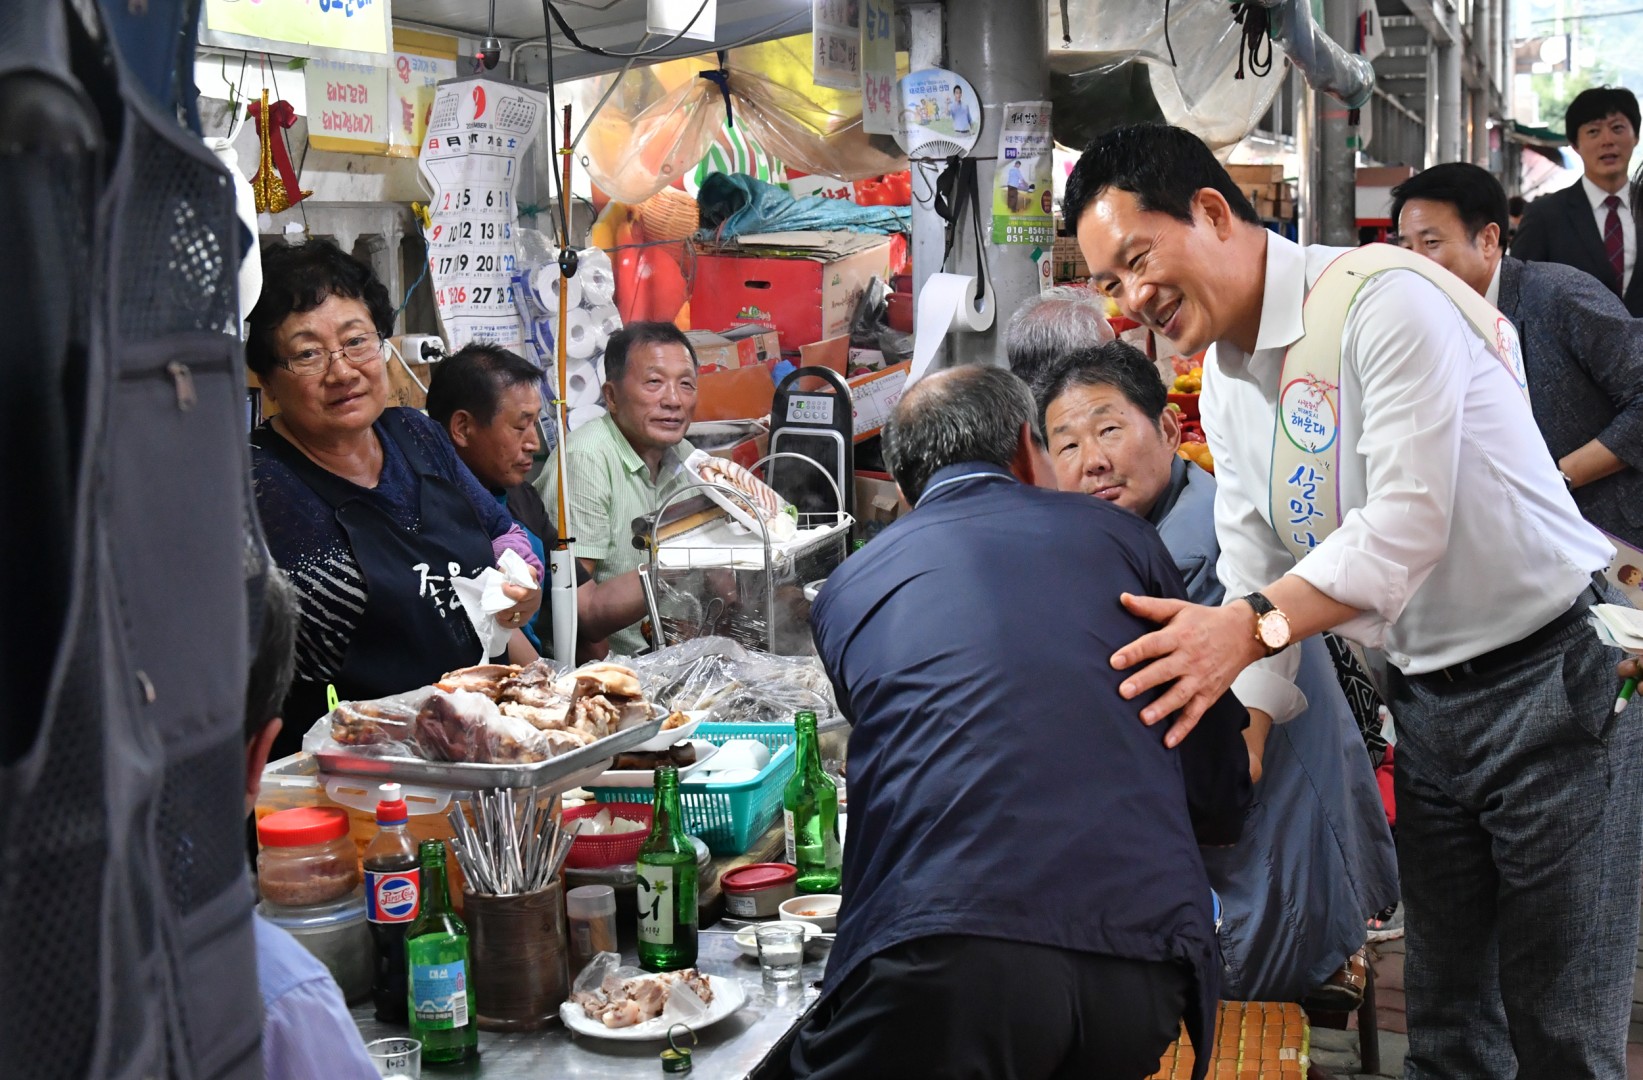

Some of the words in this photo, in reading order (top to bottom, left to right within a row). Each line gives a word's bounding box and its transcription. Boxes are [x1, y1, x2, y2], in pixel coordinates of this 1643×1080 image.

[507, 138, 517, 148] 土
[443, 192, 451, 210] 2
[463, 188, 471, 206] 5
[486, 190, 494, 207] 6
[433, 224, 443, 241] 9
[480, 222, 494, 240] 13
[439, 257, 453, 274] 17
[476, 255, 493, 271] 20
[504, 254, 515, 271] 22
[472, 287, 492, 303] 27
[1291, 411, 1326, 436] 해운대
